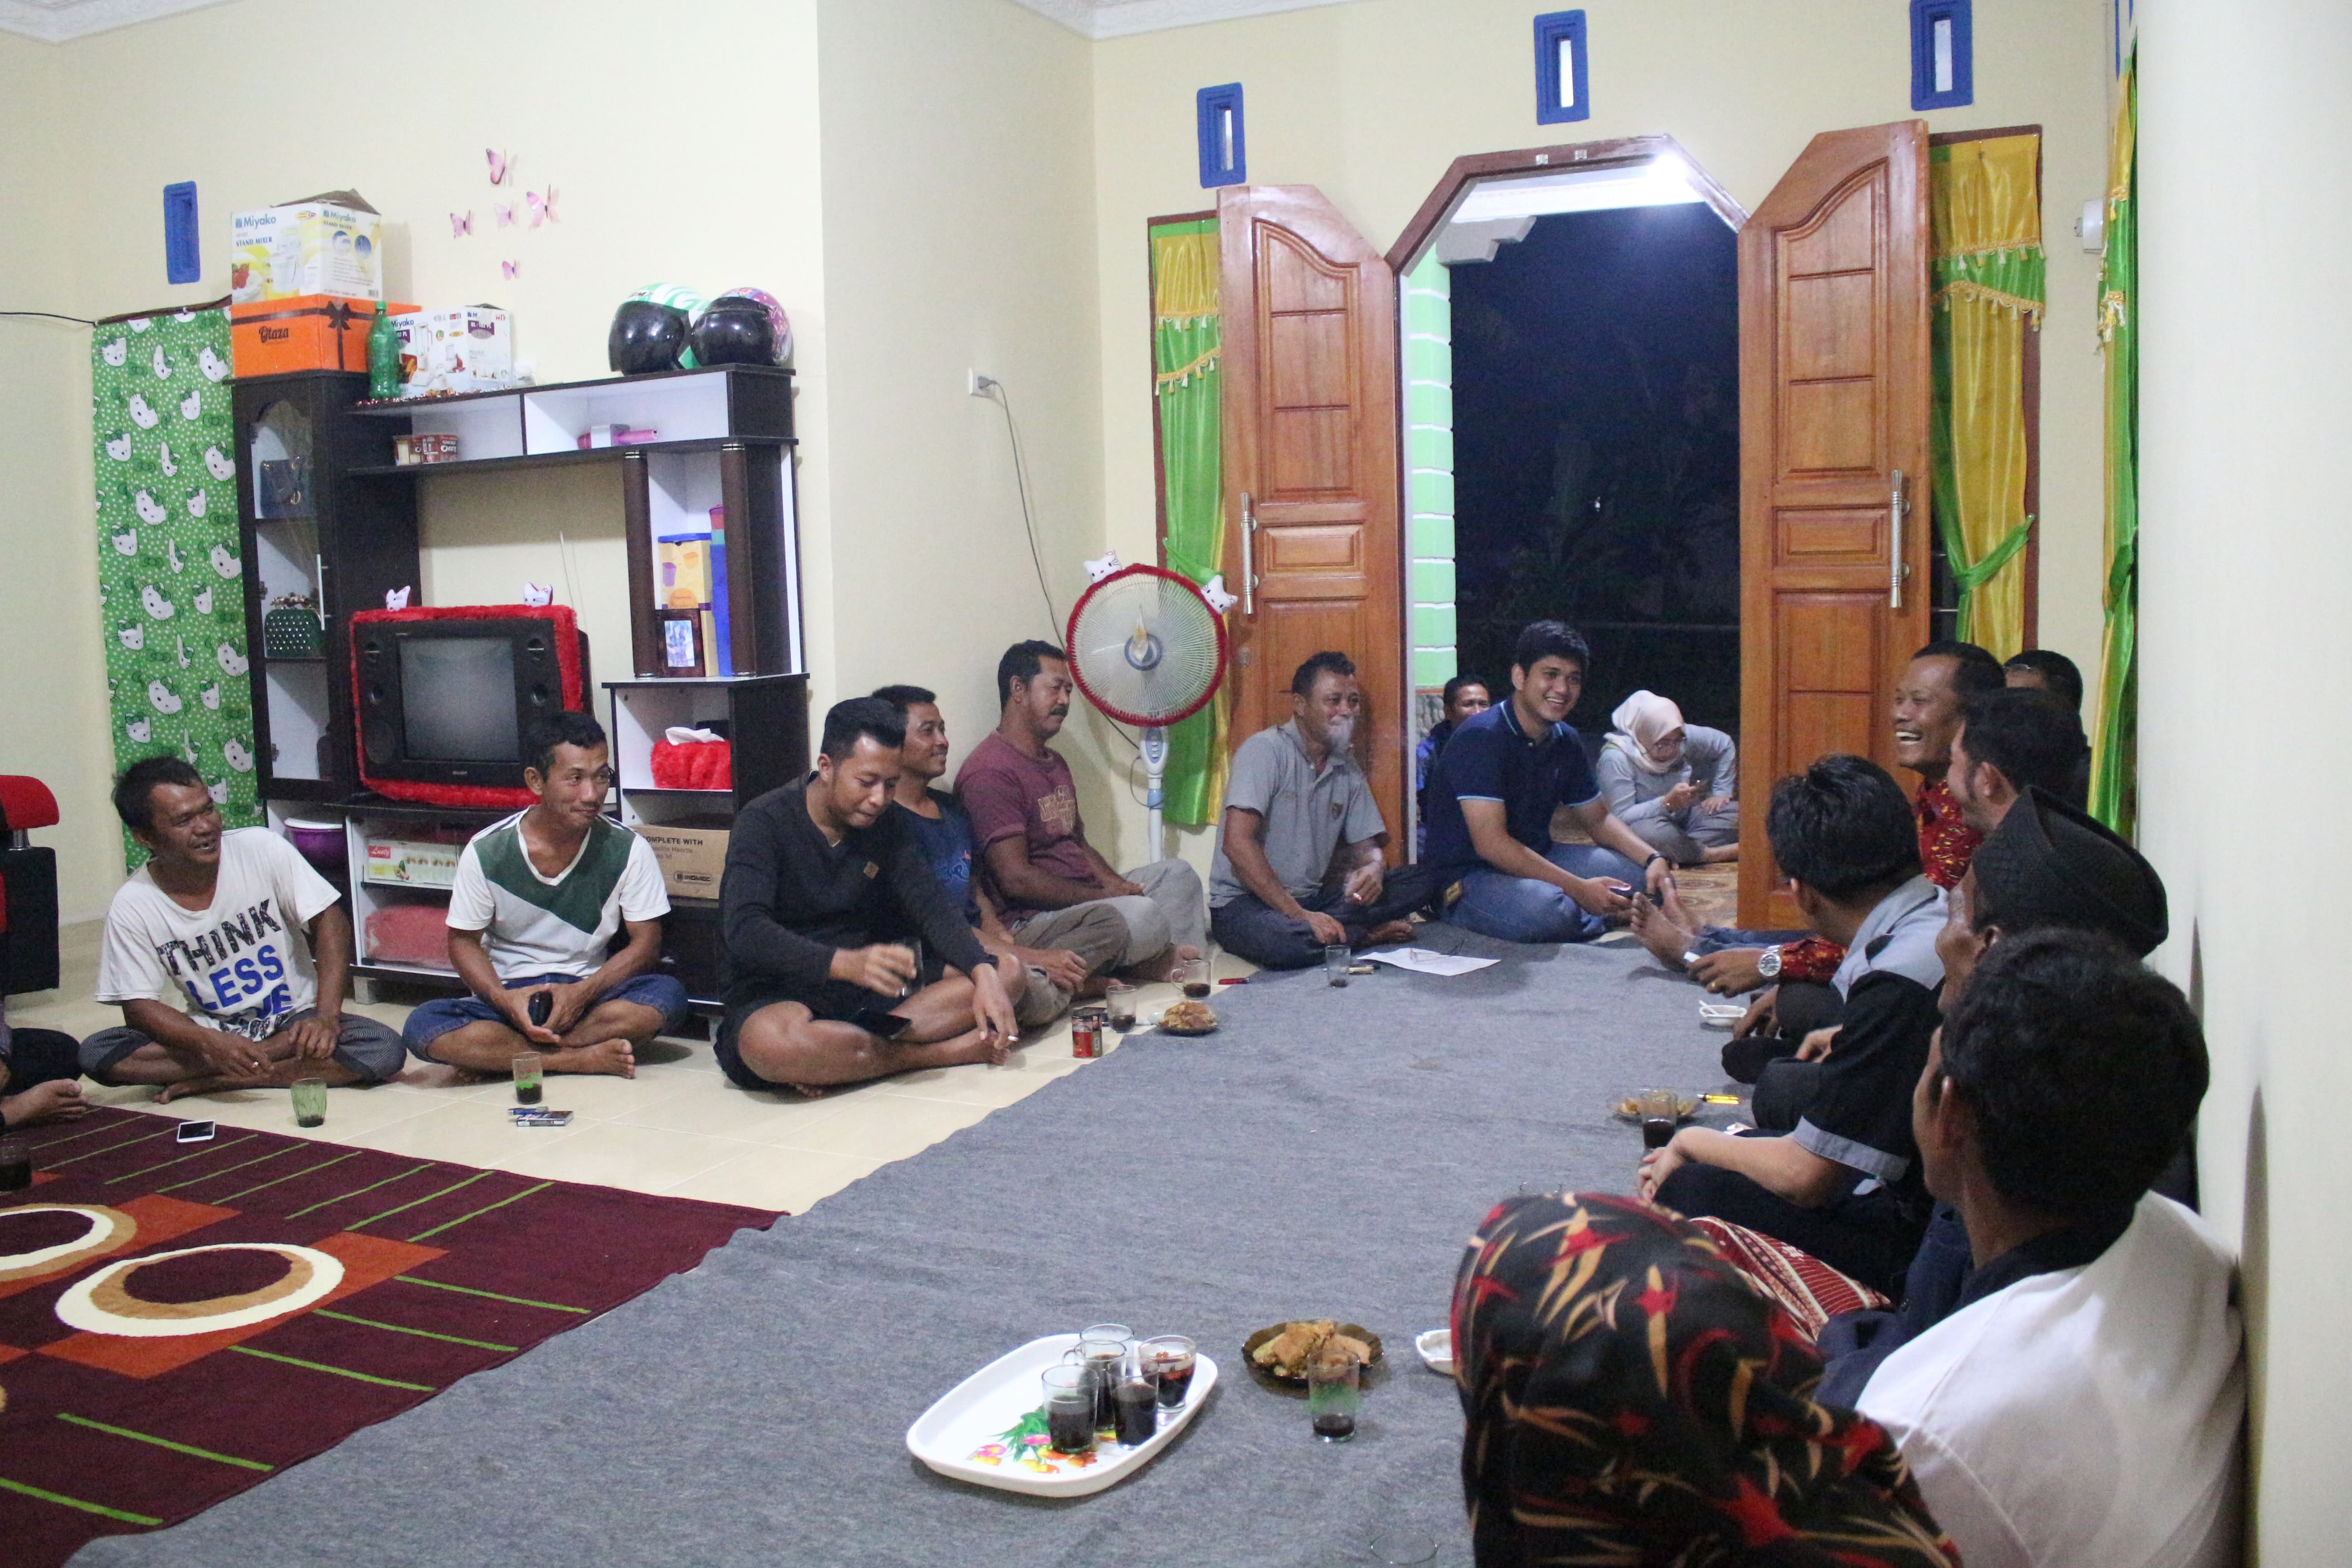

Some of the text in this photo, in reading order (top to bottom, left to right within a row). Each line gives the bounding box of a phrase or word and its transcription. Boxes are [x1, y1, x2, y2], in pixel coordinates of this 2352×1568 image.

[244, 214, 276, 230] Miyako
[330, 211, 356, 223] Miyako
[236, 236, 273, 247] STAND MIXER
[156, 898, 282, 975] THINK
[186, 945, 284, 1011] LESS
